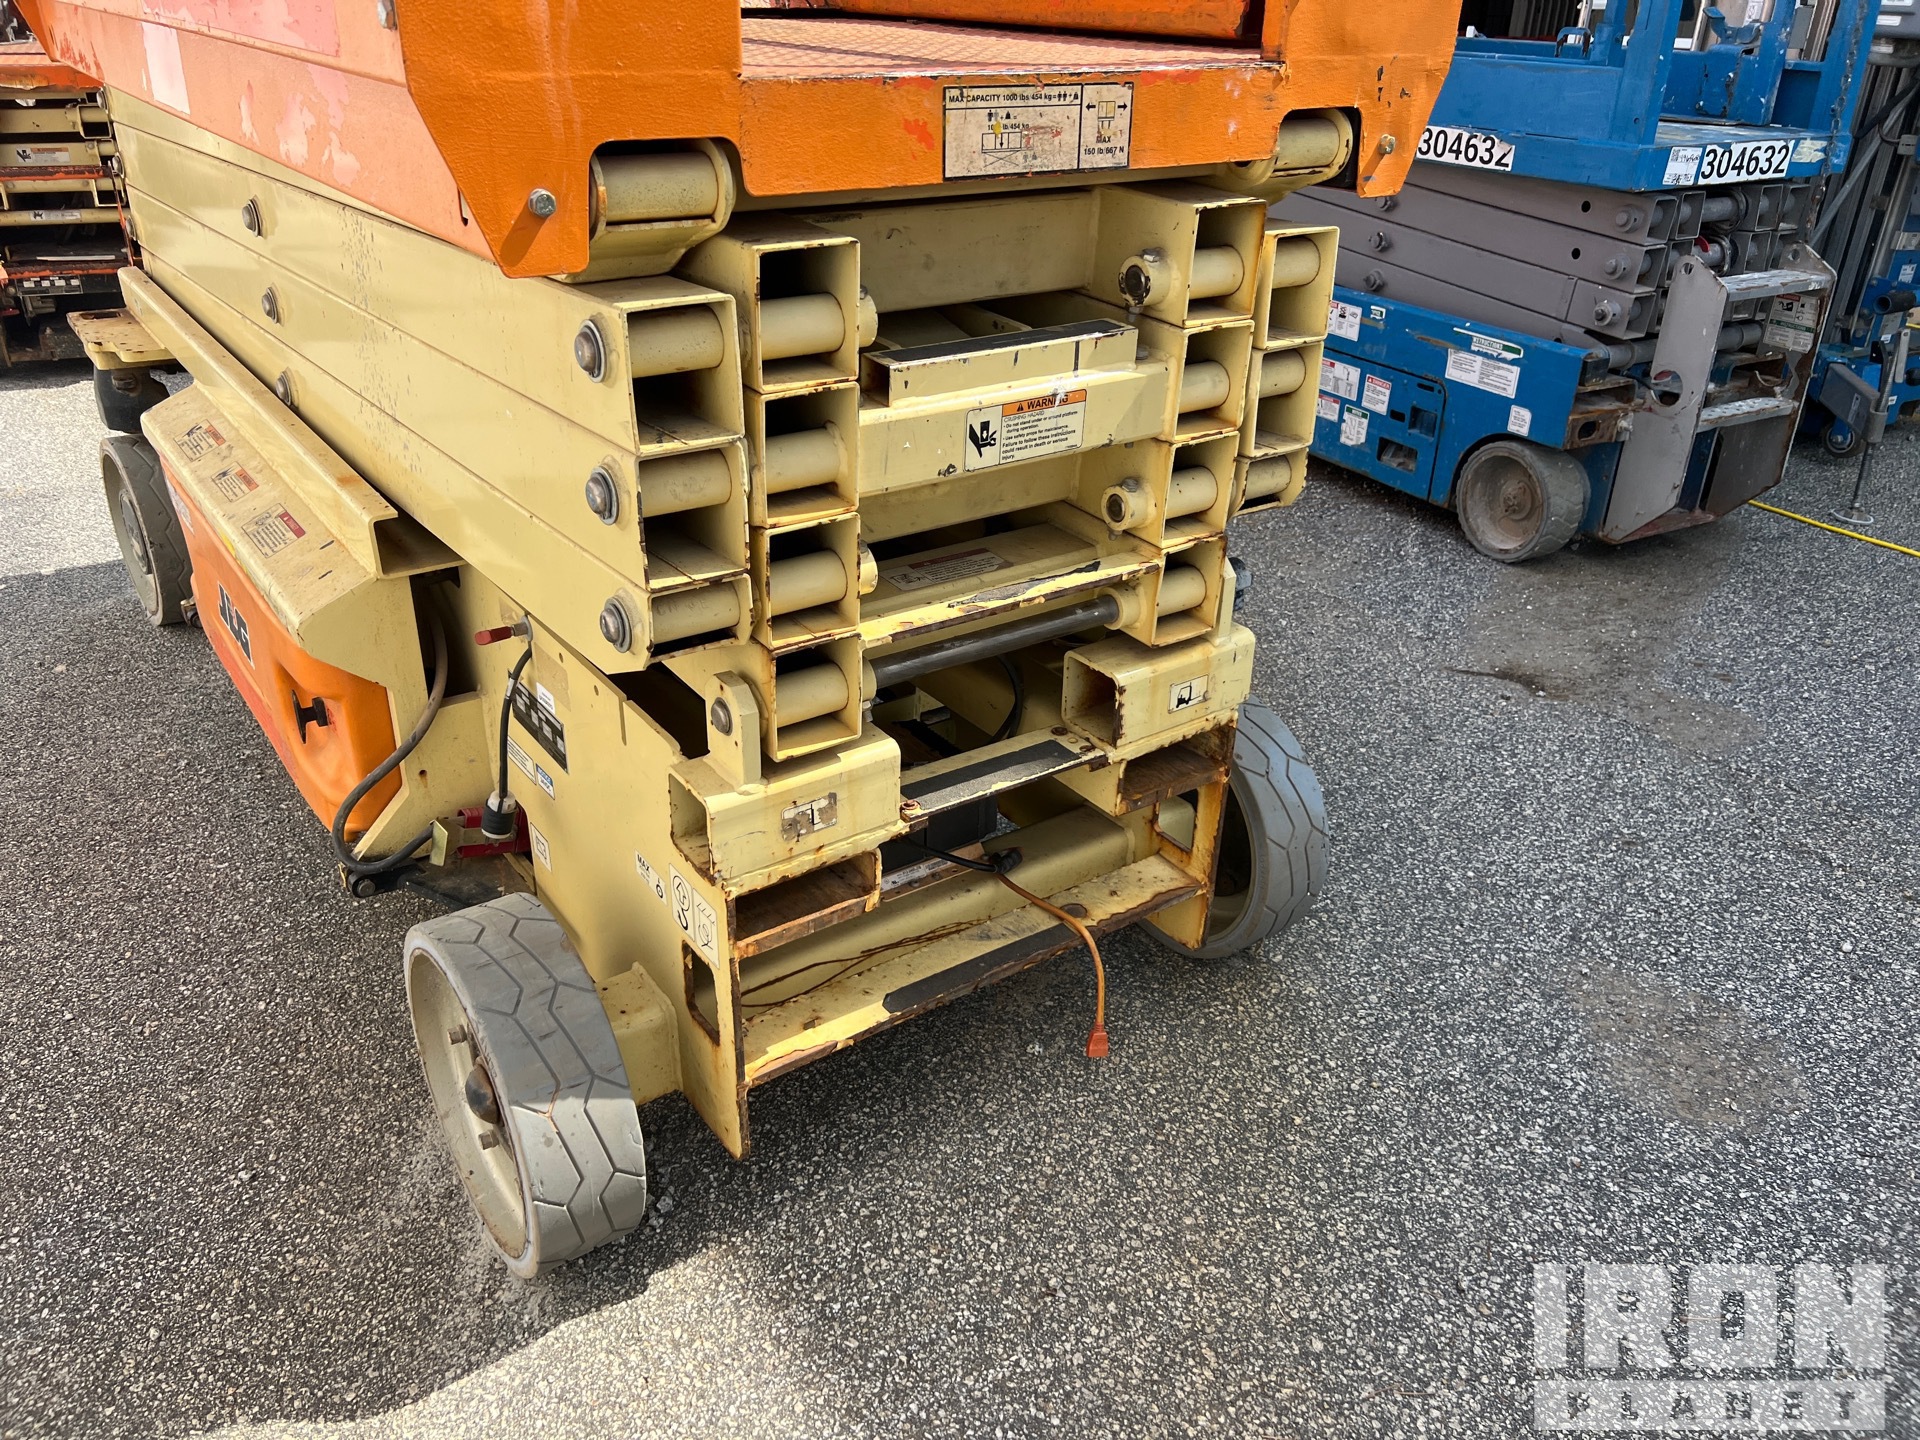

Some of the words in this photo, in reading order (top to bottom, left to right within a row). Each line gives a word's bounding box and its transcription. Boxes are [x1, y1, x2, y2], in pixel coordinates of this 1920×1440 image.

[966, 94, 1001, 102] CAPACITY
[987, 123, 1002, 131] 10
[1096, 135, 1111, 144] MAX
[1084, 147, 1096, 155] 150
[1119, 145, 1124, 153] N
[1418, 127, 1512, 168] 304632
[1701, 145, 1790, 180] 304632
[1027, 394, 1069, 410] WARNIG
[1003, 413, 1027, 423] CRUSHING
[1028, 410, 1045, 418] HAZARD
[1015, 444, 1028, 452] result
[1034, 440, 1047, 448] death
[218, 583, 252, 662] JLG
[637, 854, 650, 873] MAX
